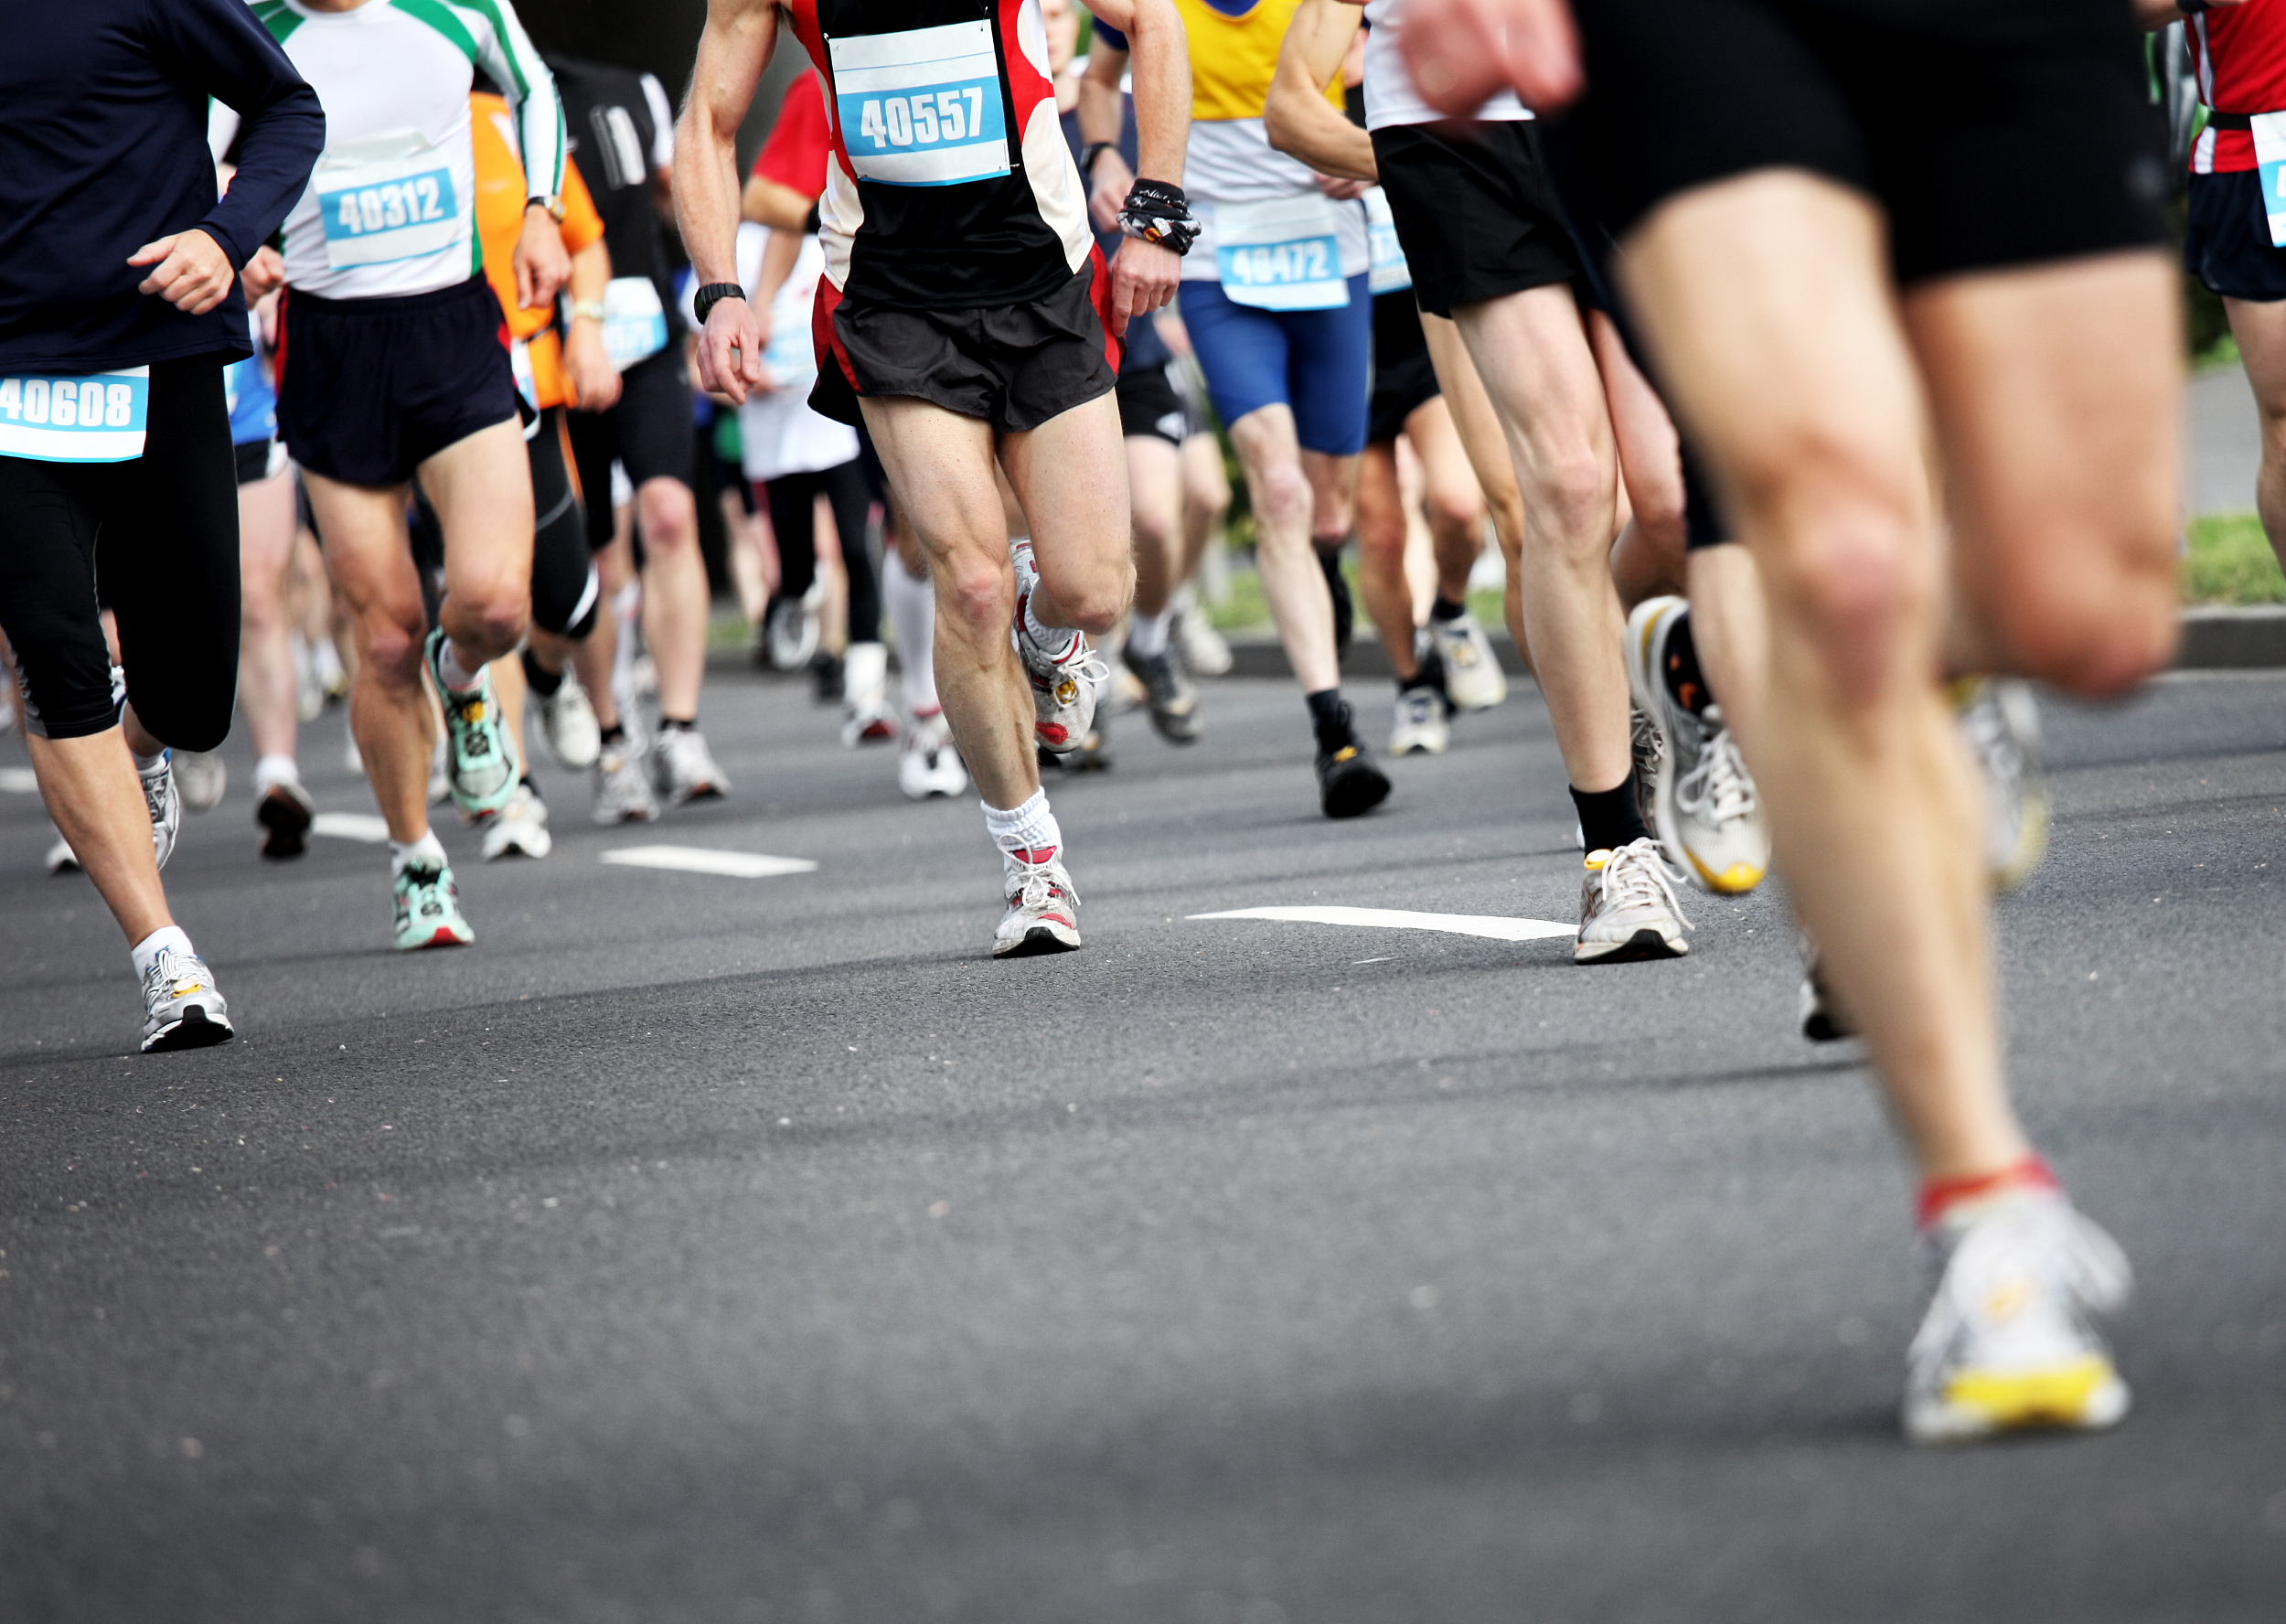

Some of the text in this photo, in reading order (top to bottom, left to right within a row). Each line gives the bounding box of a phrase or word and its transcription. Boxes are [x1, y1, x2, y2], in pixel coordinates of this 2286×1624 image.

[860, 86, 983, 148] 40557
[338, 176, 444, 234] 40312
[0, 378, 133, 427] 40608
